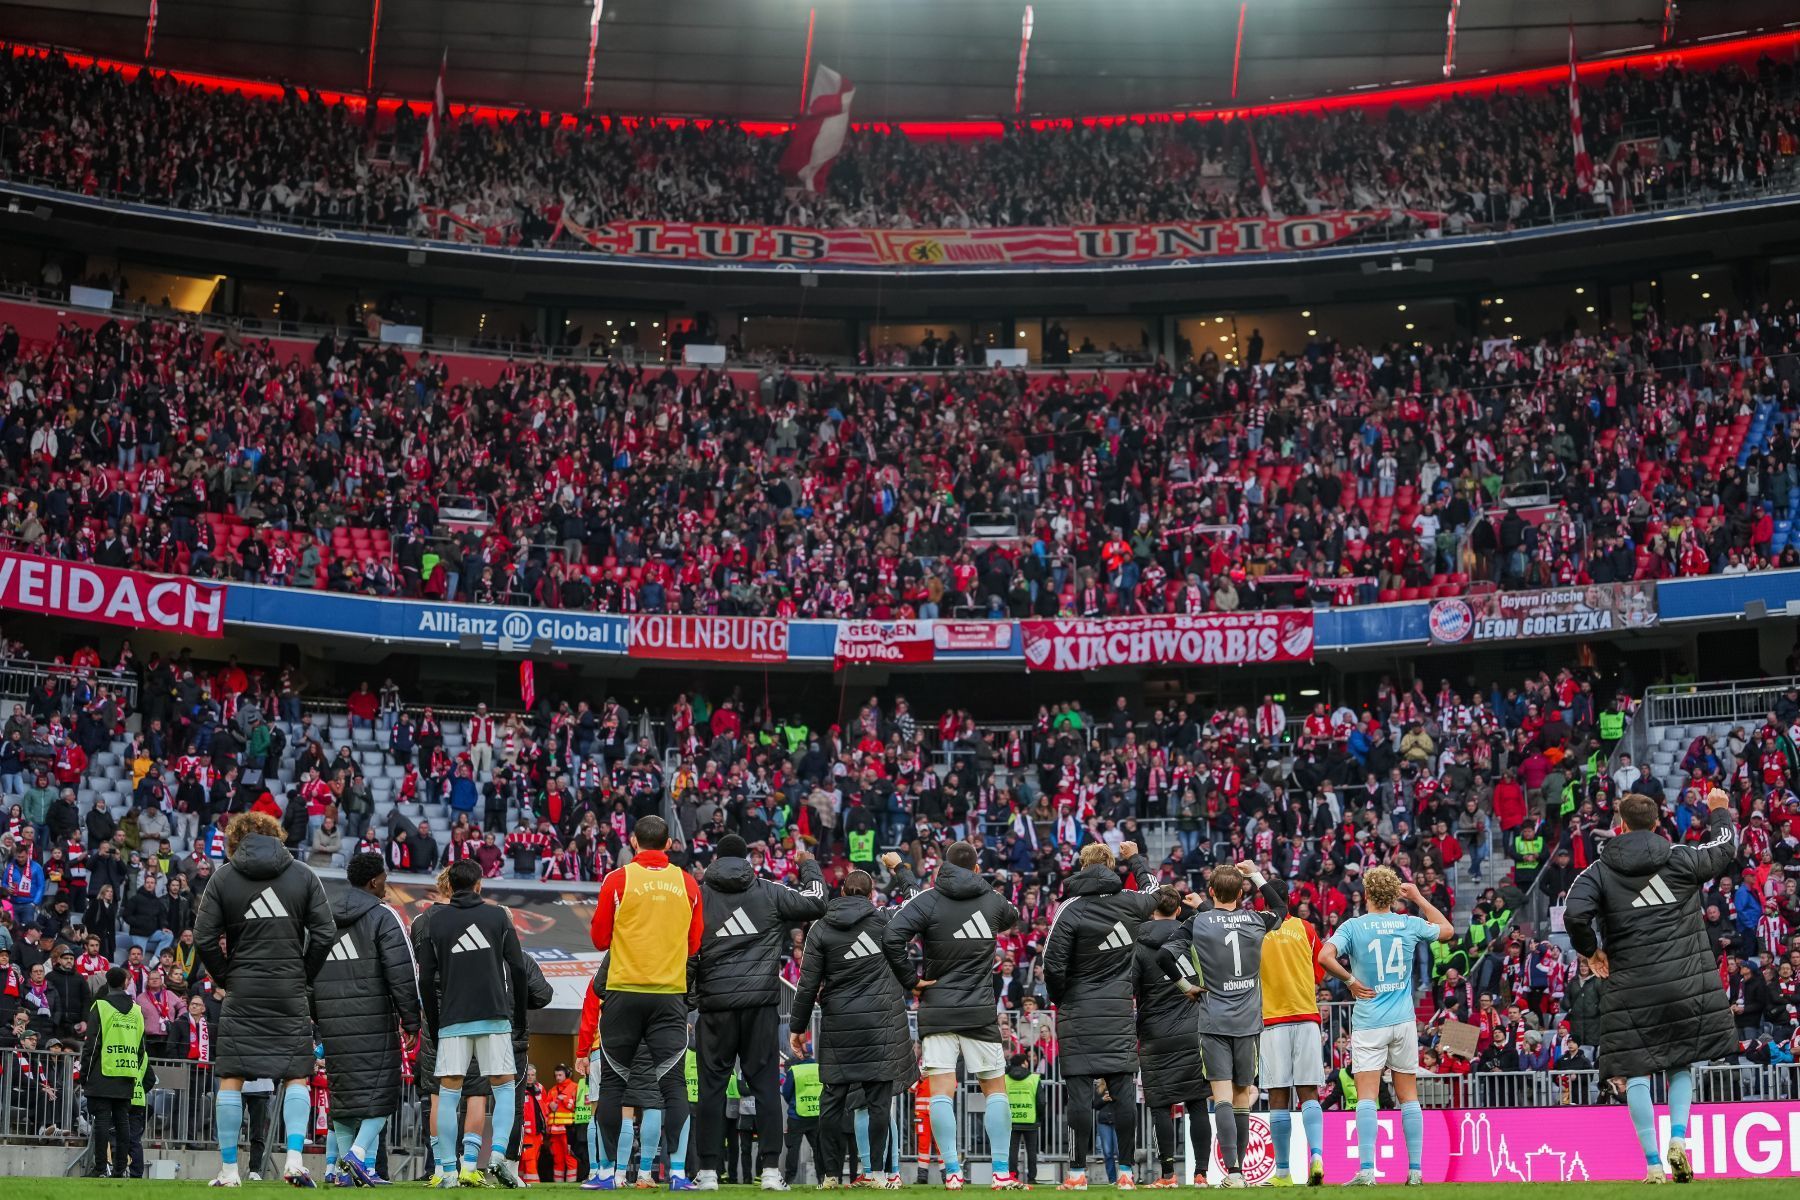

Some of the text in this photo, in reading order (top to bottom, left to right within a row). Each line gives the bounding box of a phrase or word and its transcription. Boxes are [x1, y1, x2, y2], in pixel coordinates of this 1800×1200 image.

[1501, 592, 1540, 610] Bayern
[418, 610, 498, 636] Allianz
[537, 618, 611, 643] Global
[630, 615, 787, 651] KOLLNBURG
[1174, 614, 1280, 629] Bavaria
[1473, 617, 1519, 639] LEON
[1522, 609, 1613, 635] GORETZKA
[1053, 628, 1279, 671] KIRCHWORBIS
[643, 880, 655, 893] FC
[657, 880, 684, 897] Union
[1208, 914, 1253, 924] 1. FC UNION
[1371, 922, 1380, 930] FC
[1381, 920, 1405, 929] UNION
[1224, 930, 1242, 977] 1
[1367, 936, 1407, 982] 14
[1223, 979, 1255, 991] RÖNNOW
